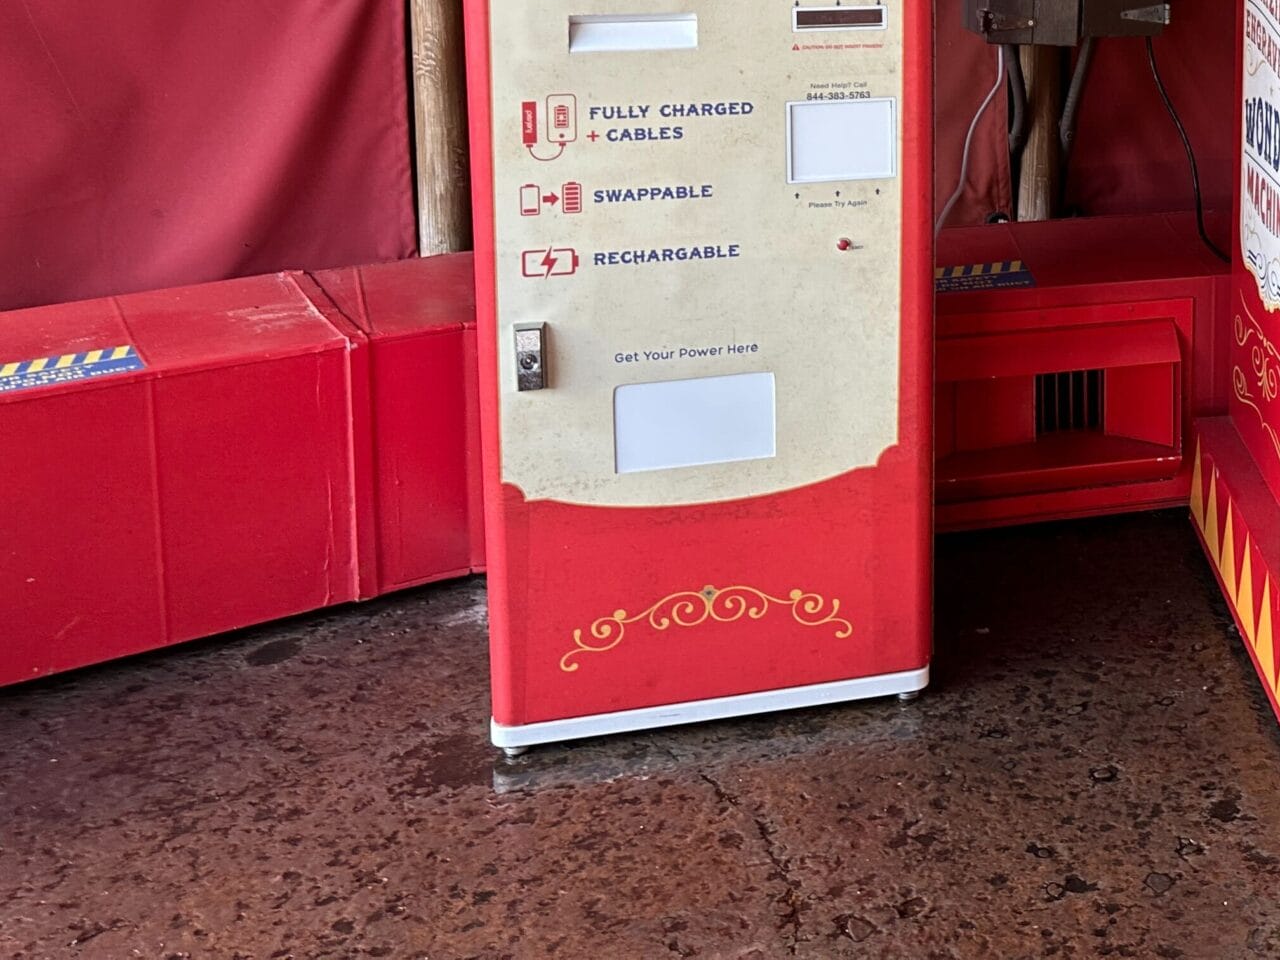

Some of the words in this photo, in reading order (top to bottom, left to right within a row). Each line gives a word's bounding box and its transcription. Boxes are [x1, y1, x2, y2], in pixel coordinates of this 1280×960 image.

[589, 105, 650, 120] FULLY
[659, 102, 754, 118] CHARGED
[606, 126, 684, 142] CABLES
[593, 185, 714, 203] SWAPPABLE
[834, 200, 845, 208] Try
[847, 200, 868, 208] Again
[593, 244, 741, 266] RECHARGABLE
[614, 351, 639, 364] Get
[643, 349, 675, 362] Your
[679, 345, 723, 359] Power
[727, 342, 759, 355] Here
